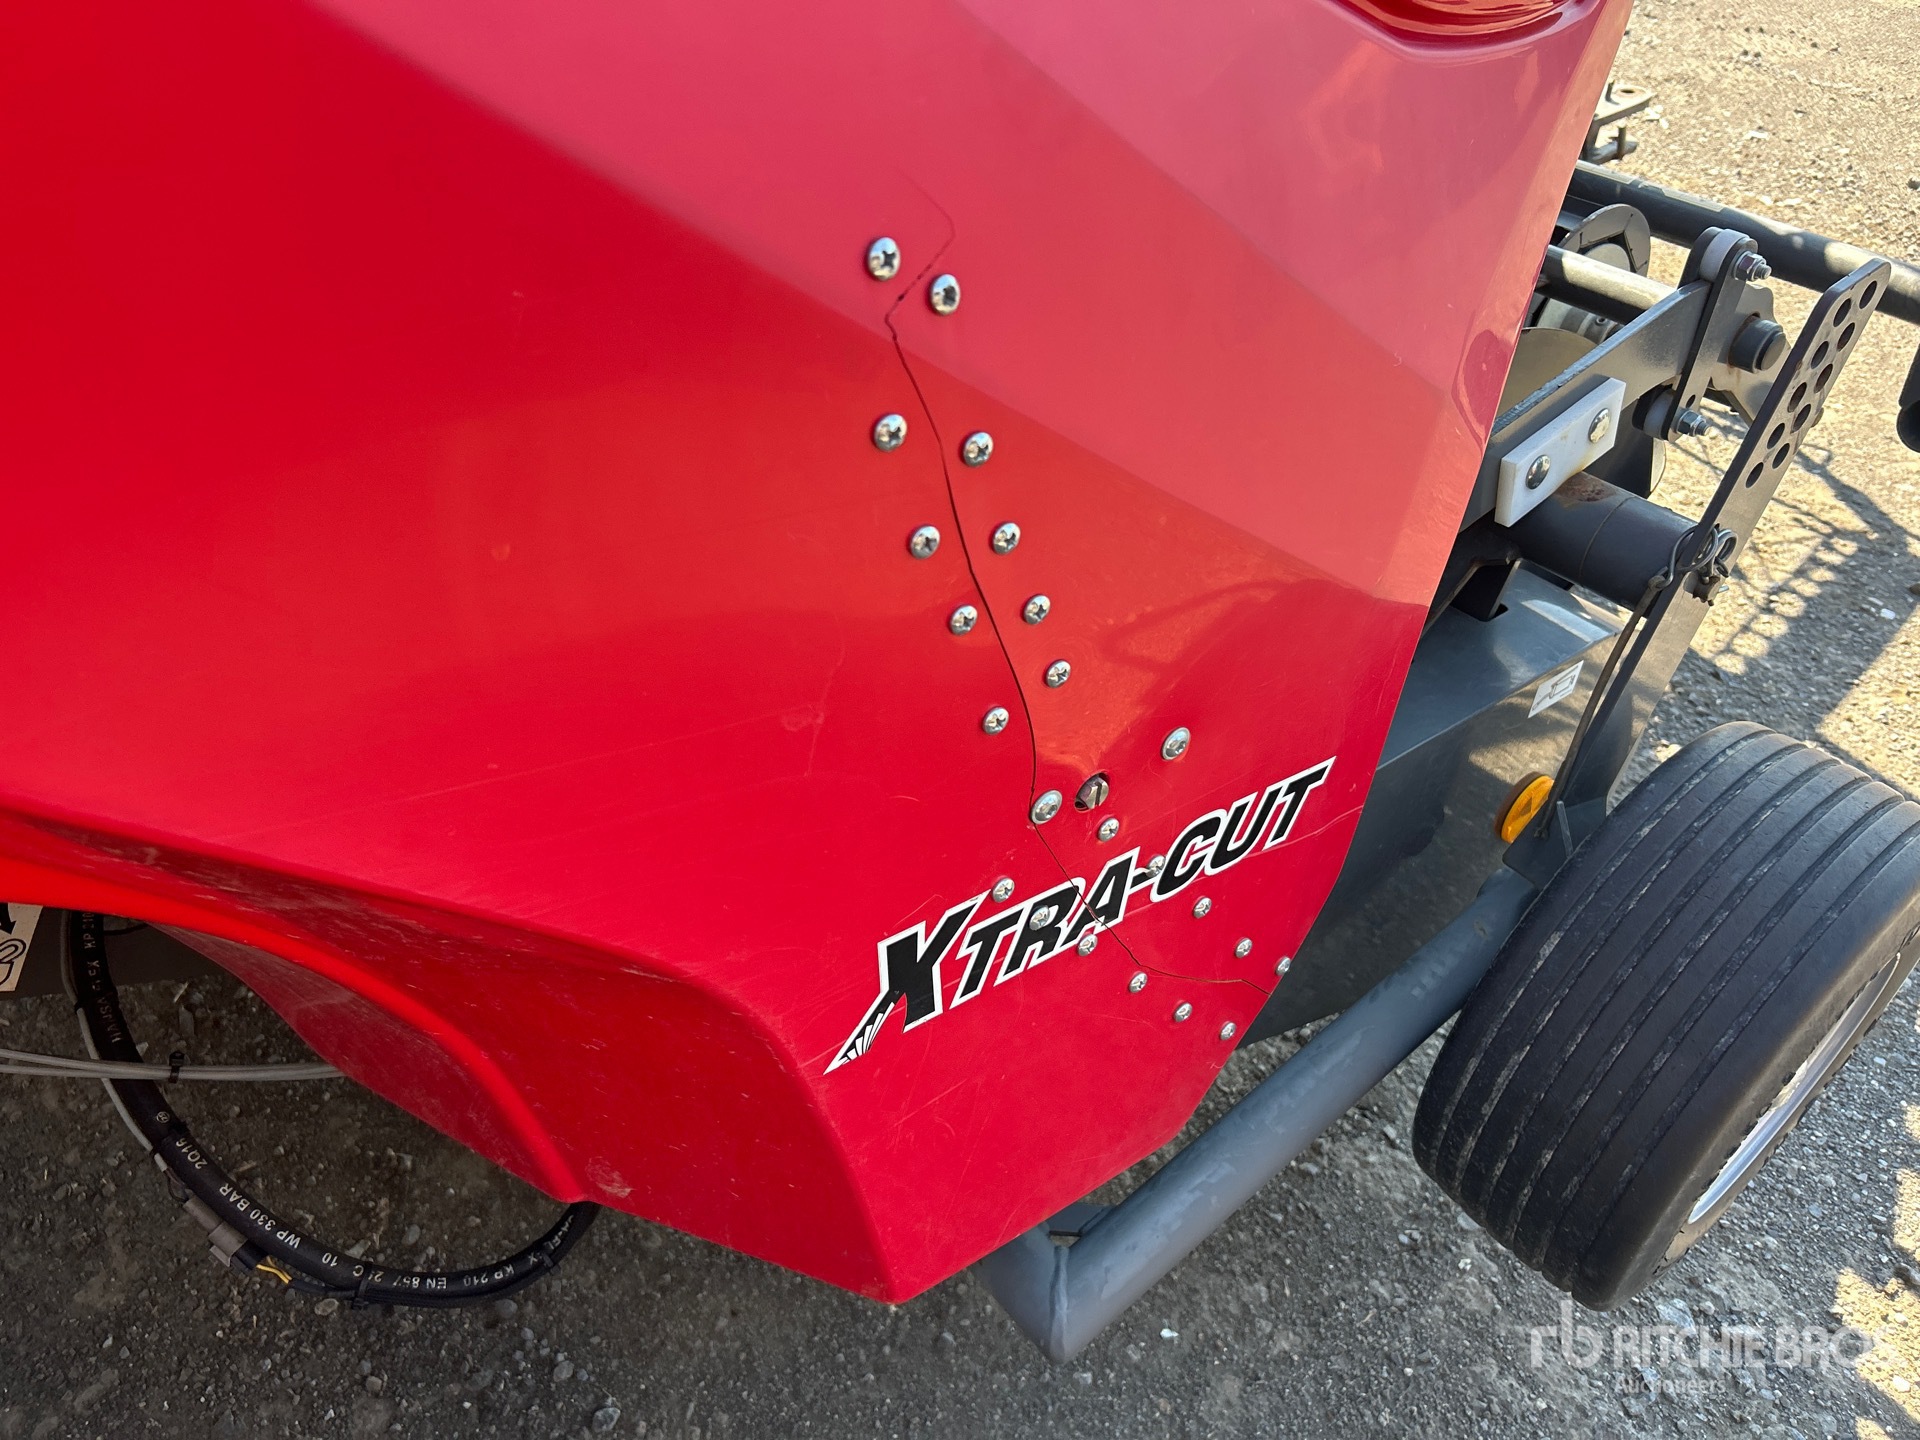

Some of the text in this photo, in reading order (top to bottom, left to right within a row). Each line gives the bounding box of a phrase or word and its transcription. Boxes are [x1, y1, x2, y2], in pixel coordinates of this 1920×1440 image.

[824, 757, 1336, 1074] XTRA-CUT
[219, 1182, 251, 1212] BAR
[249, 1208, 277, 1231] 330
[276, 1229, 302, 1249] WP
[321, 1252, 338, 1267] 10
[462, 1269, 489, 1287] 210
[494, 1263, 515, 1280] KP
[426, 1277, 447, 1289] EN
